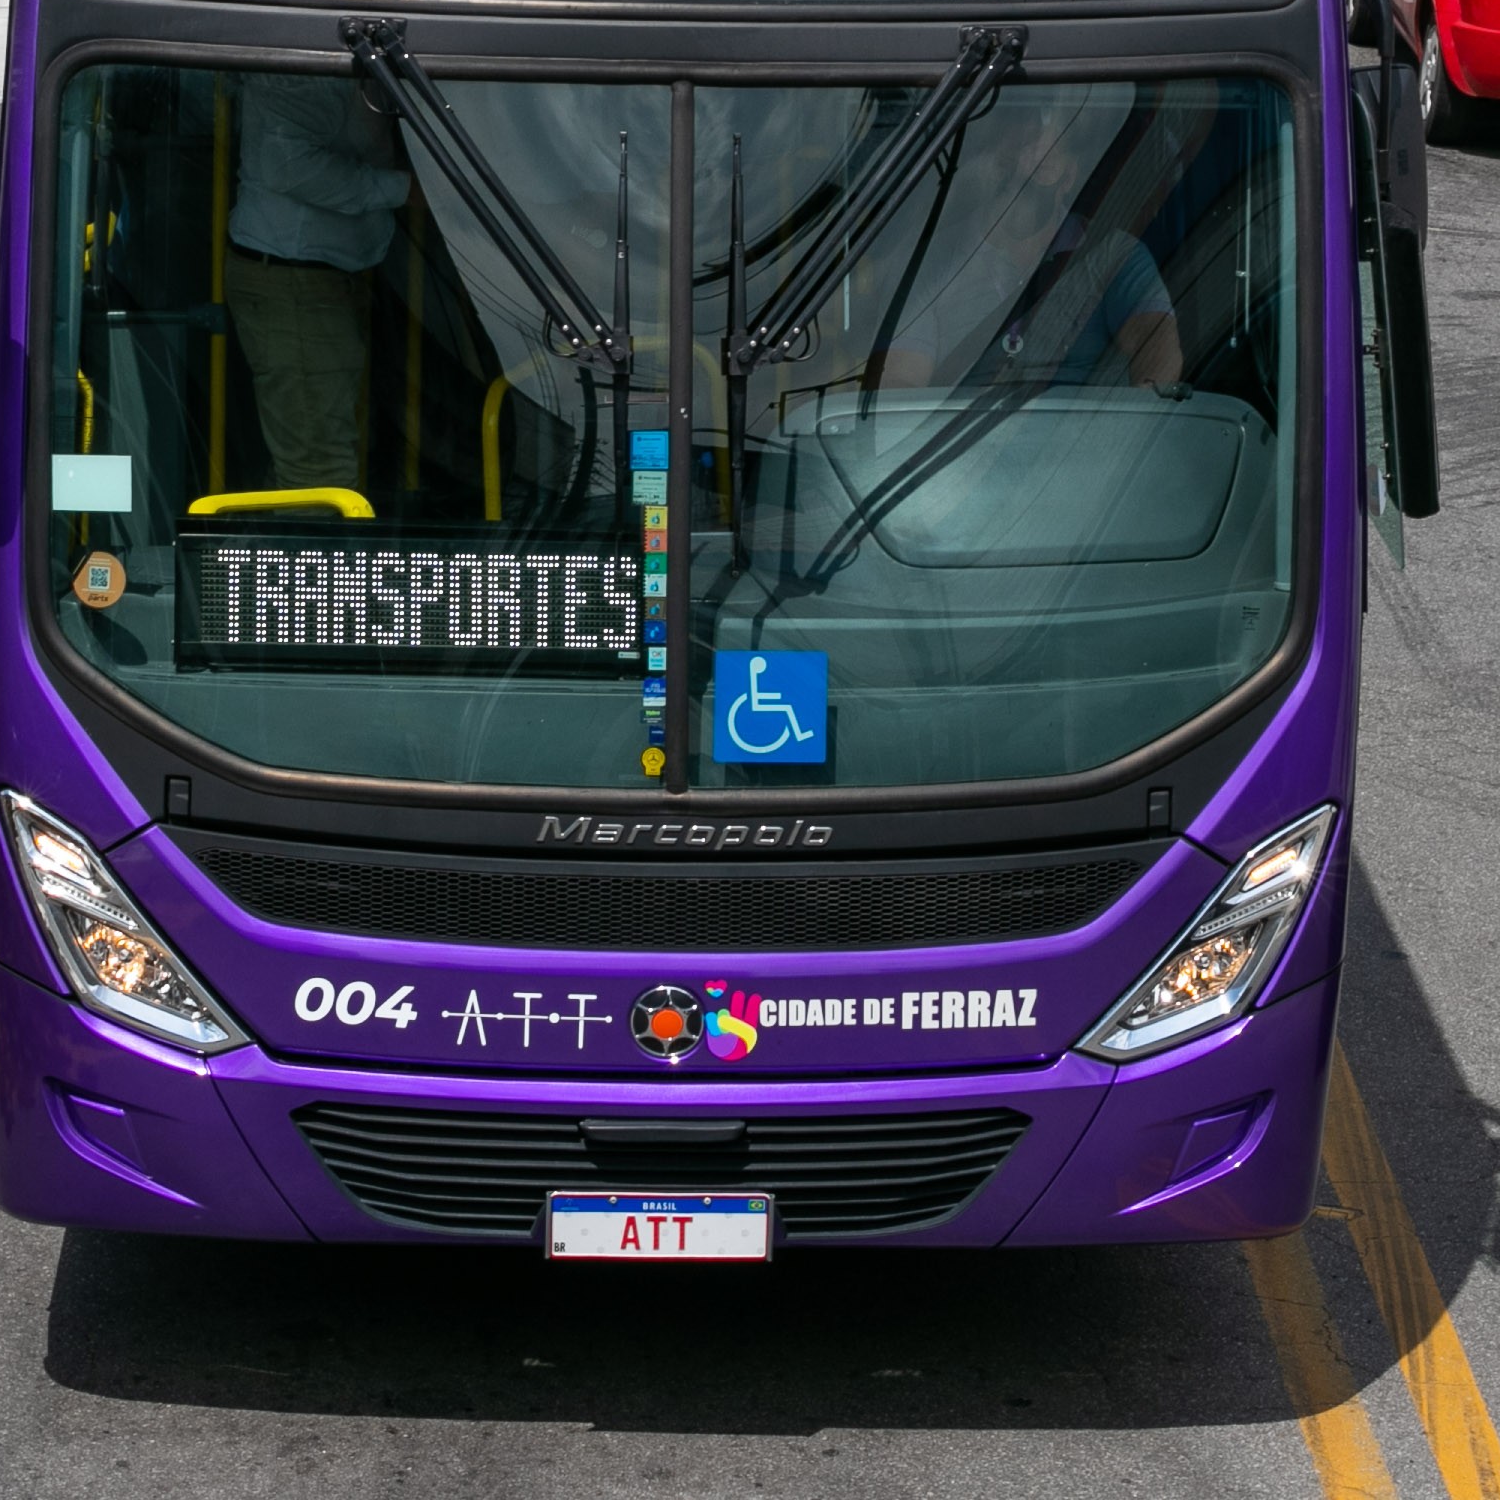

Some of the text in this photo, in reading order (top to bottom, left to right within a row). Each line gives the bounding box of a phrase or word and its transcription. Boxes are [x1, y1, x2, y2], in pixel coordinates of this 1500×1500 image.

[217, 549, 637, 649] TRANSPORTES
[536, 815, 834, 851] Marcopolo
[294, 977, 418, 1030] 004
[758, 988, 1038, 1030] CIDADE DE FERRAZ
[642, 1201, 678, 1211] BRASIL
[554, 1242, 567, 1253] BR
[620, 1215, 693, 1251] ATT
